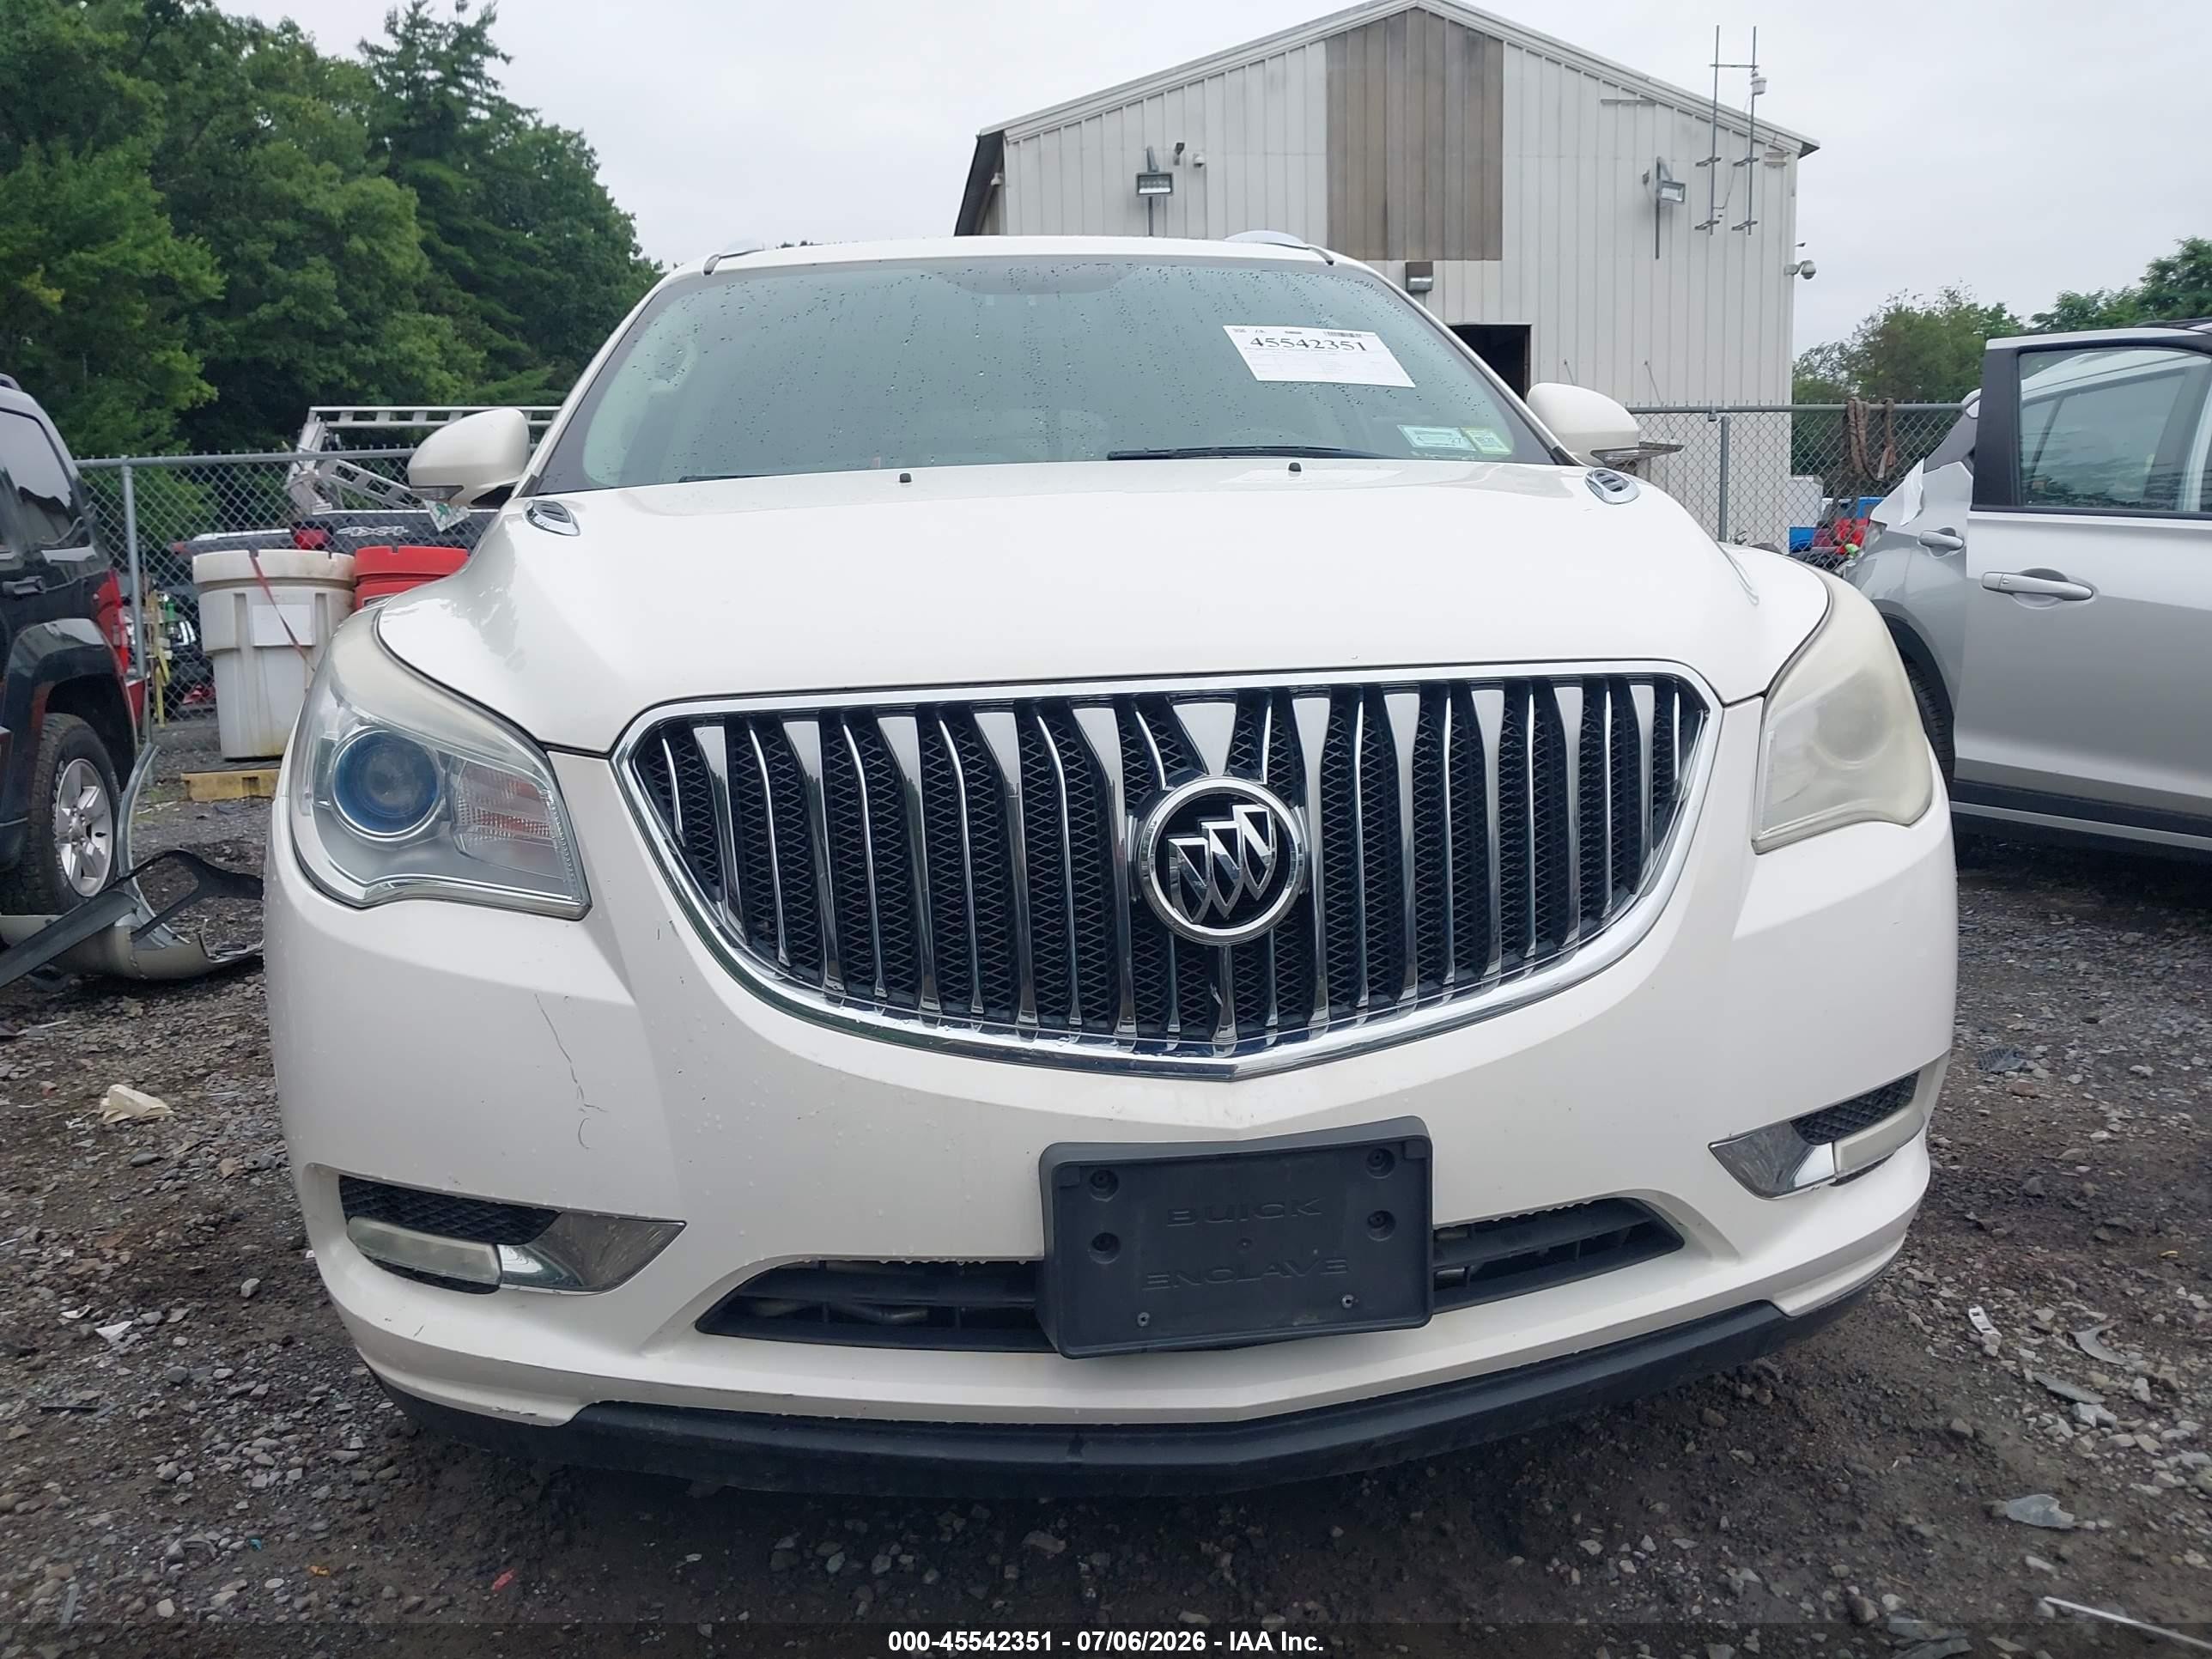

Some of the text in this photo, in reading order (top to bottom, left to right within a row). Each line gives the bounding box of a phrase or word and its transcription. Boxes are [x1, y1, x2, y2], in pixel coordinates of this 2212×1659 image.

[1249, 337, 1367, 351] 45542351
[1167, 1198, 1322, 1227] BUICK
[1142, 1259, 1347, 1291] ENCLAVE
